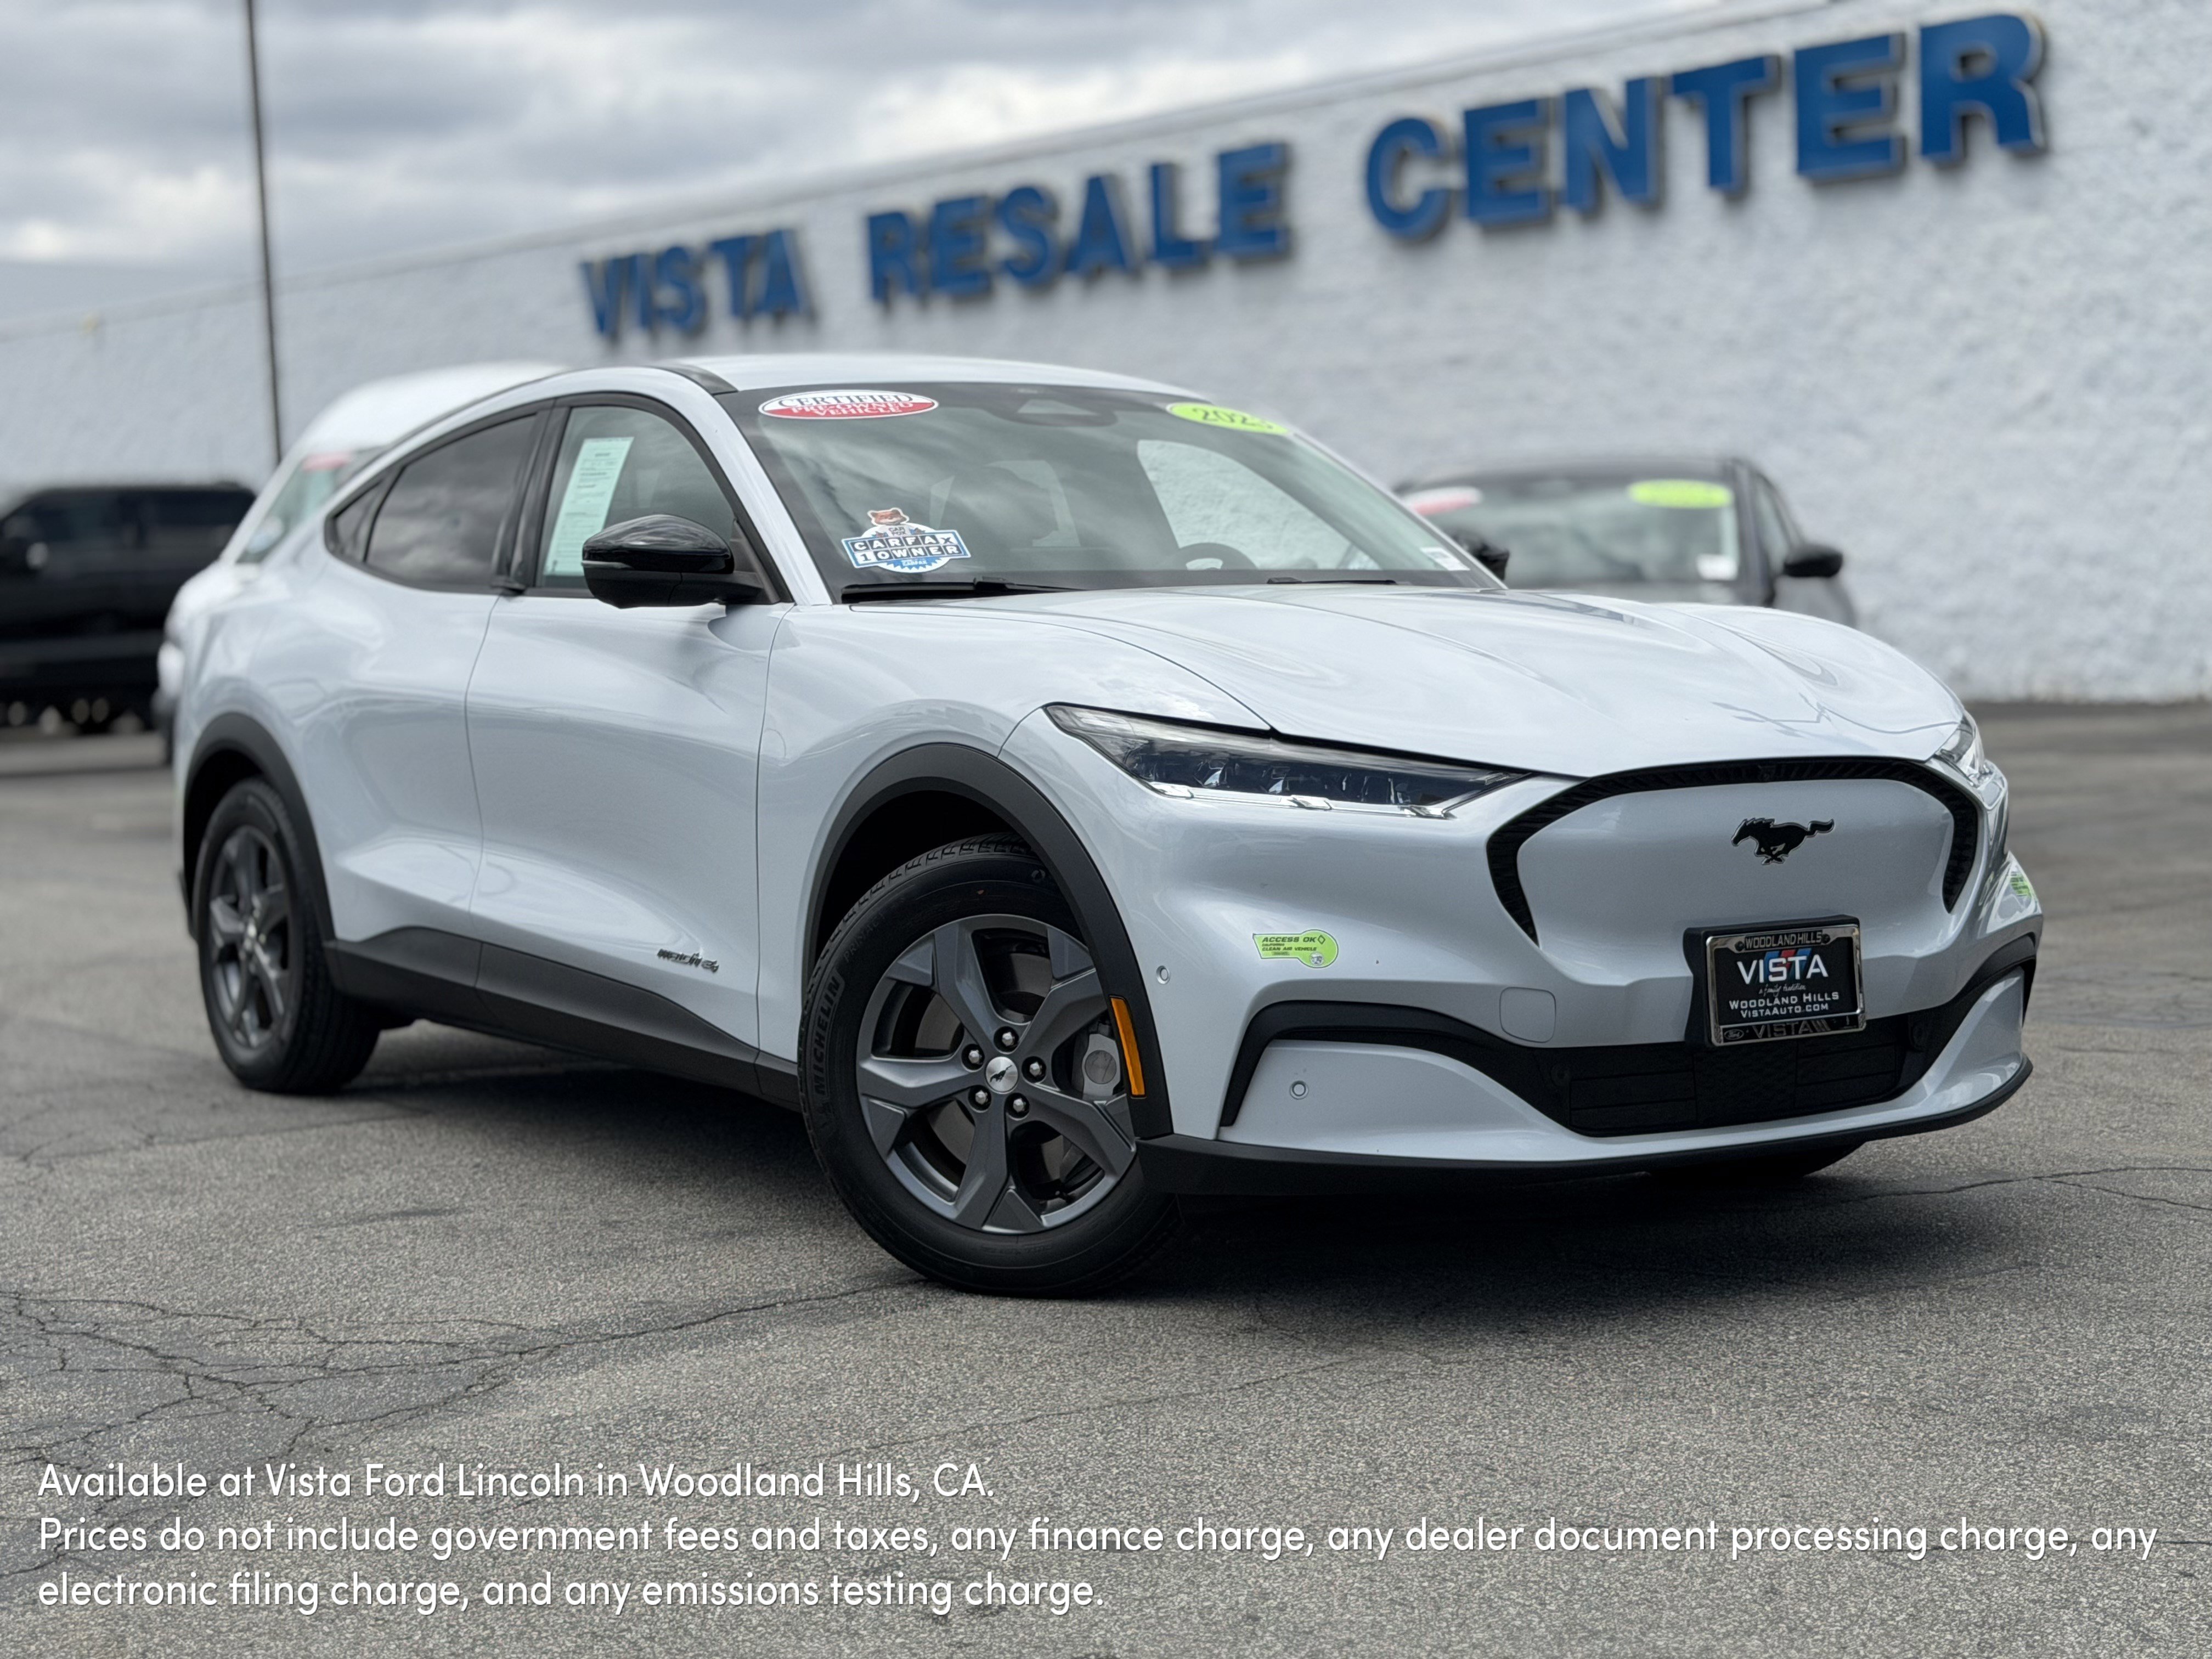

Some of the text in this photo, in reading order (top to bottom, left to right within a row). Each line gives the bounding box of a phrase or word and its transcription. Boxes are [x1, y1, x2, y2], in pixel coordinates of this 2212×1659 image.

[580, 12, 2042, 336] VISTA RESALE CENTER
[778, 394, 913, 407] CERTIFIED
[854, 534, 955, 550] CARFAX
[859, 545, 960, 562] 1 OWNER
[1737, 953, 1829, 985] VISTA
[1729, 992, 1839, 1010] WOODLAND HILLS
[814, 975, 841, 1096] MICHELIN
[1752, 1019, 1815, 1039] VISTA
